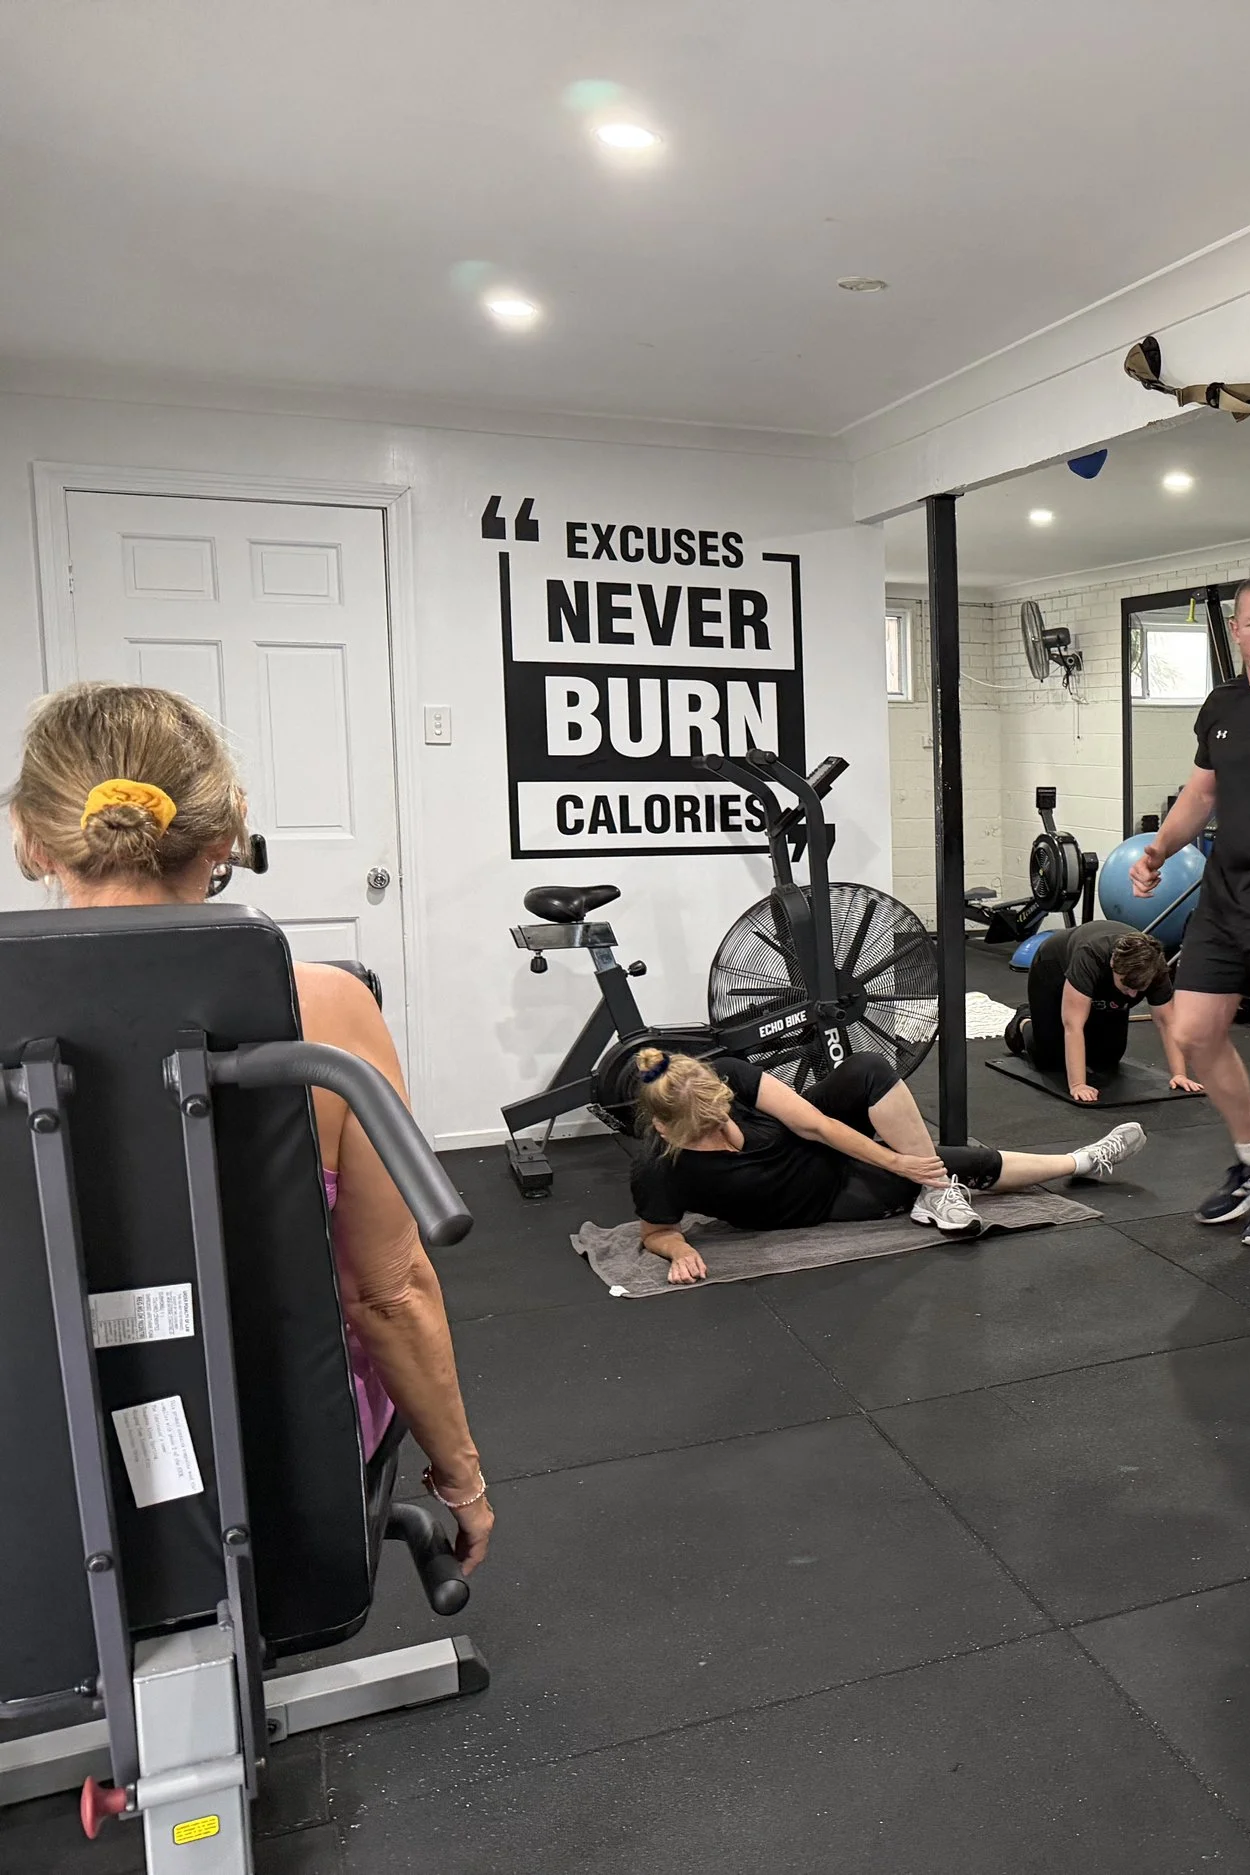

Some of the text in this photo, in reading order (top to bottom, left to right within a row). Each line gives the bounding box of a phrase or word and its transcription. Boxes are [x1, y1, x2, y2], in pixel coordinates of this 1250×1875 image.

[566, 521, 744, 569] EXCUSES
[546, 578, 772, 651] NEVER
[544, 674, 780, 759] BURN
[555, 793, 768, 836] CALORIES
[759, 1010, 808, 1039] ECHO BIKE
[824, 1027, 846, 1070] RO
